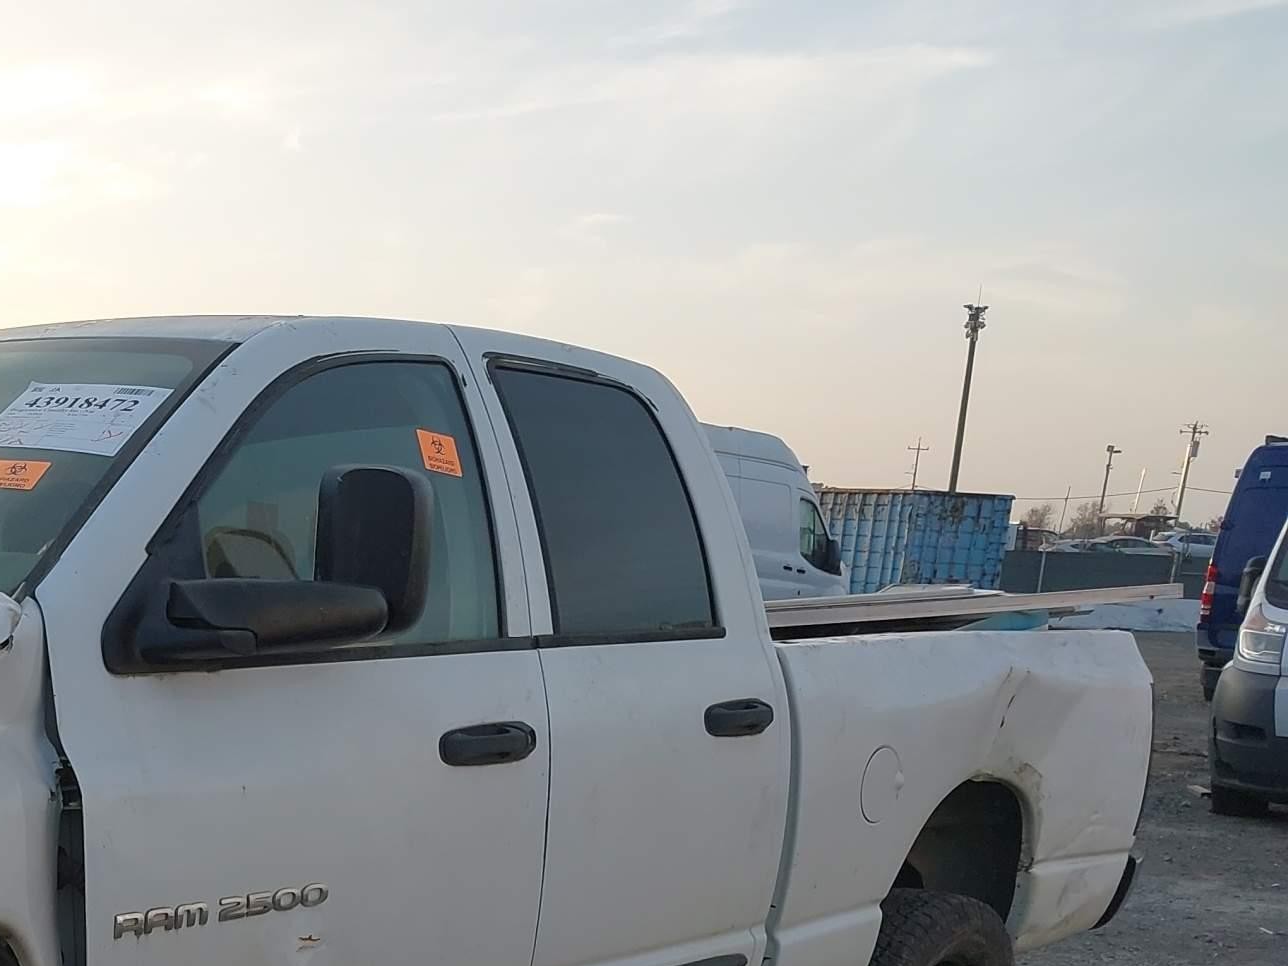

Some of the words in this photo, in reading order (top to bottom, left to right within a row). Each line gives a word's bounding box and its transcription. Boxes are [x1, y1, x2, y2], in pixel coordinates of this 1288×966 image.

[24, 396, 140, 412] 43918472
[113, 901, 209, 940] RAM
[218, 882, 329, 923] 2500
